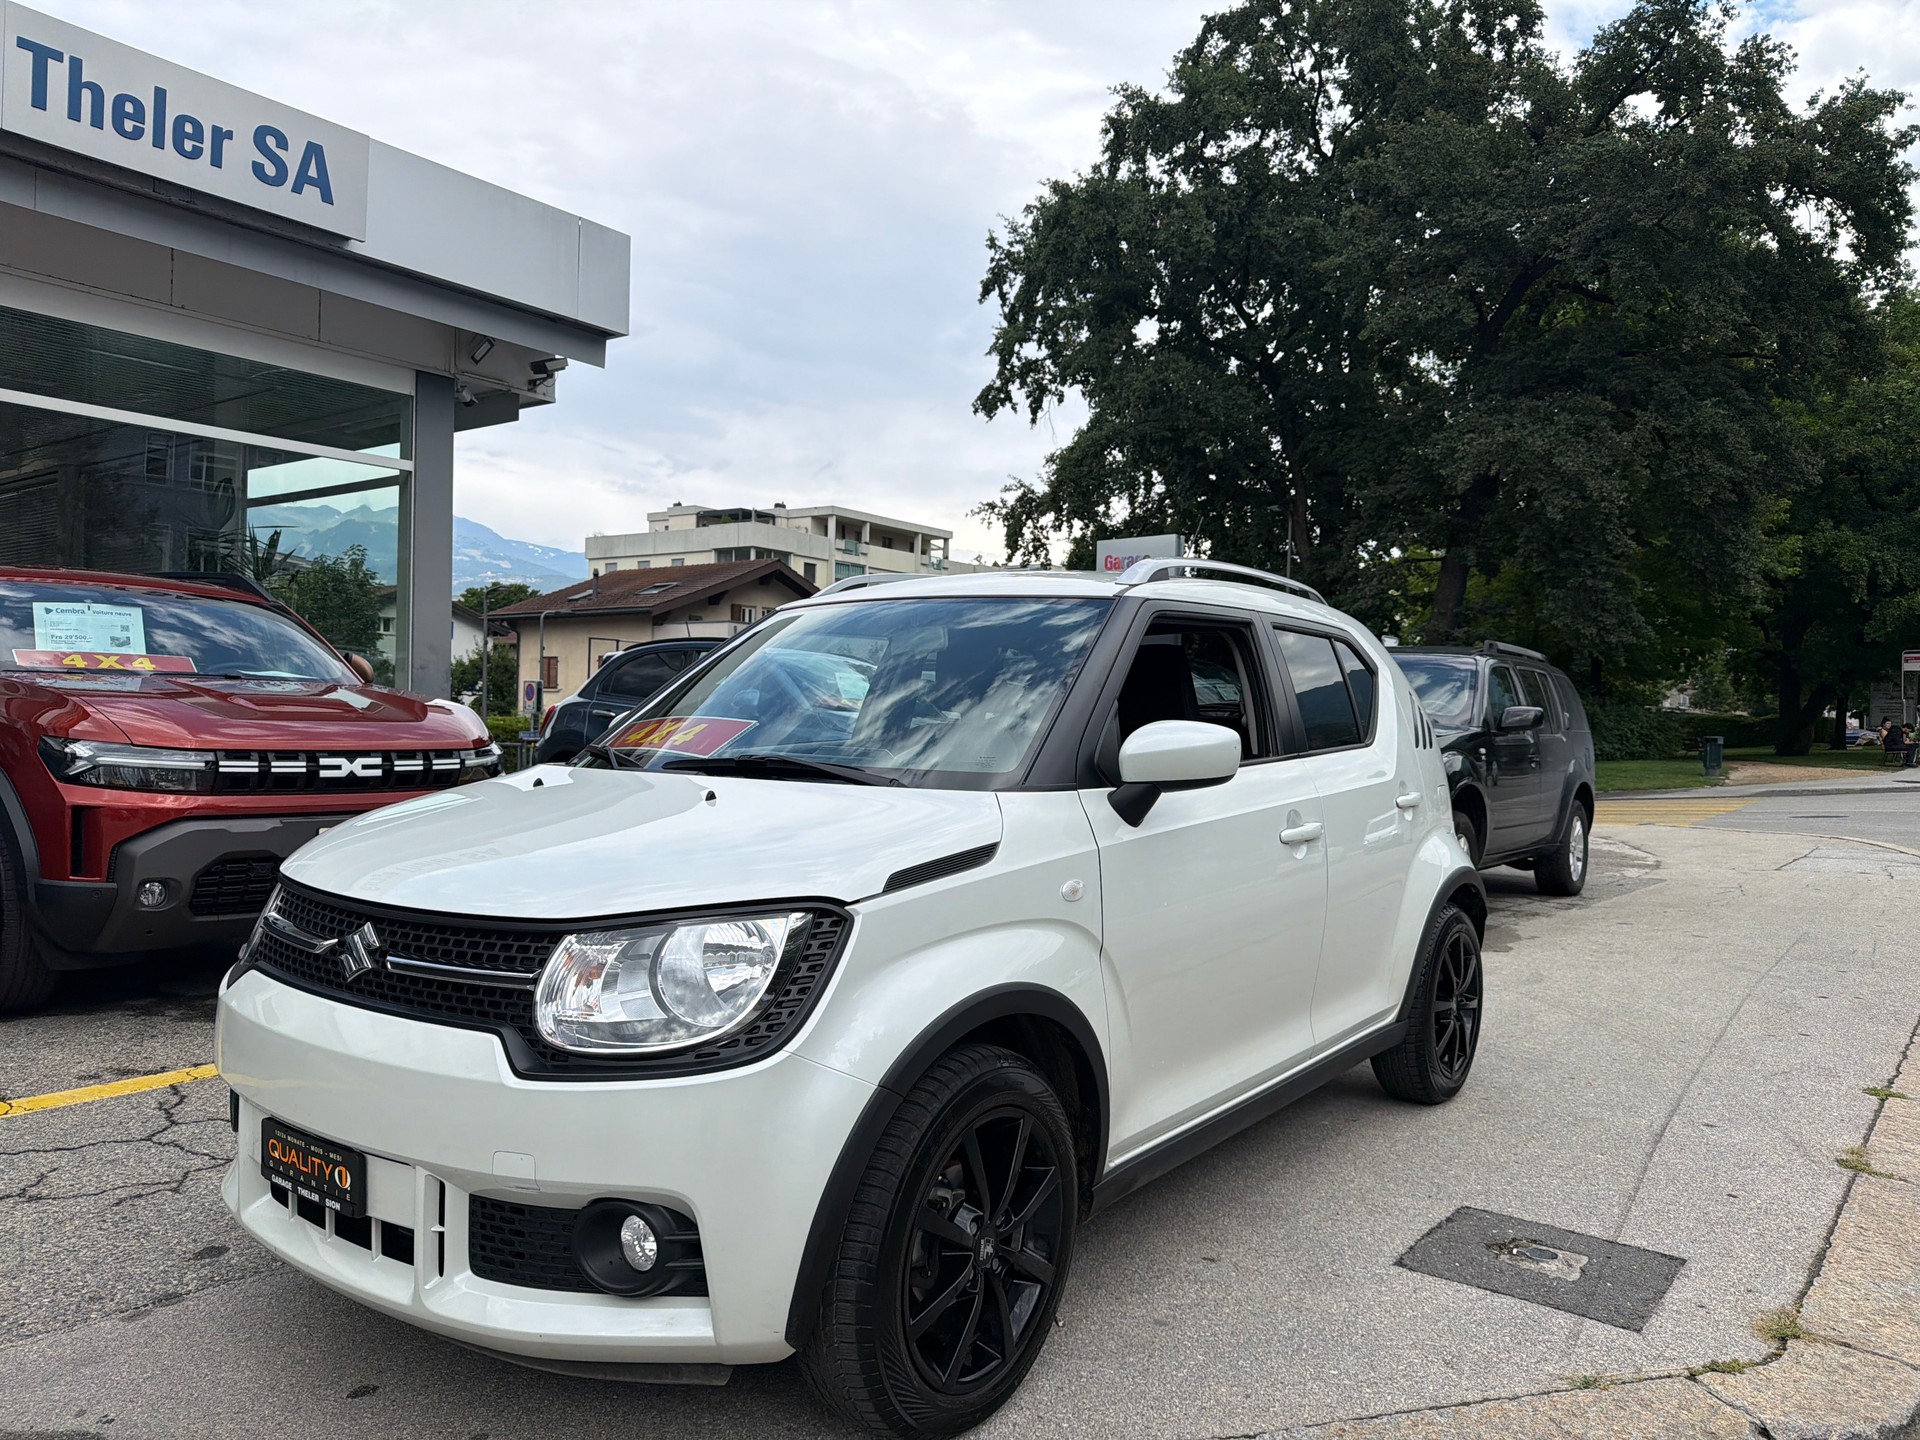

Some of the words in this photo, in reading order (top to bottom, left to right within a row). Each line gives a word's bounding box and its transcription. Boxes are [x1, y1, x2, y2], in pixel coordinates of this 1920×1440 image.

[16, 36, 234, 169] Theler
[251, 124, 335, 206] SA
[625, 721, 709, 746] 4X4
[268, 1138, 334, 1181] QUALITY
[310, 1145, 323, 1155] MOIS
[329, 1151, 342, 1162] MESI
[268, 1160, 351, 1201] GARANTIE
[271, 1174, 293, 1191] GARAGE
[297, 1186, 320, 1203] THELER
[325, 1198, 341, 1211] SION
